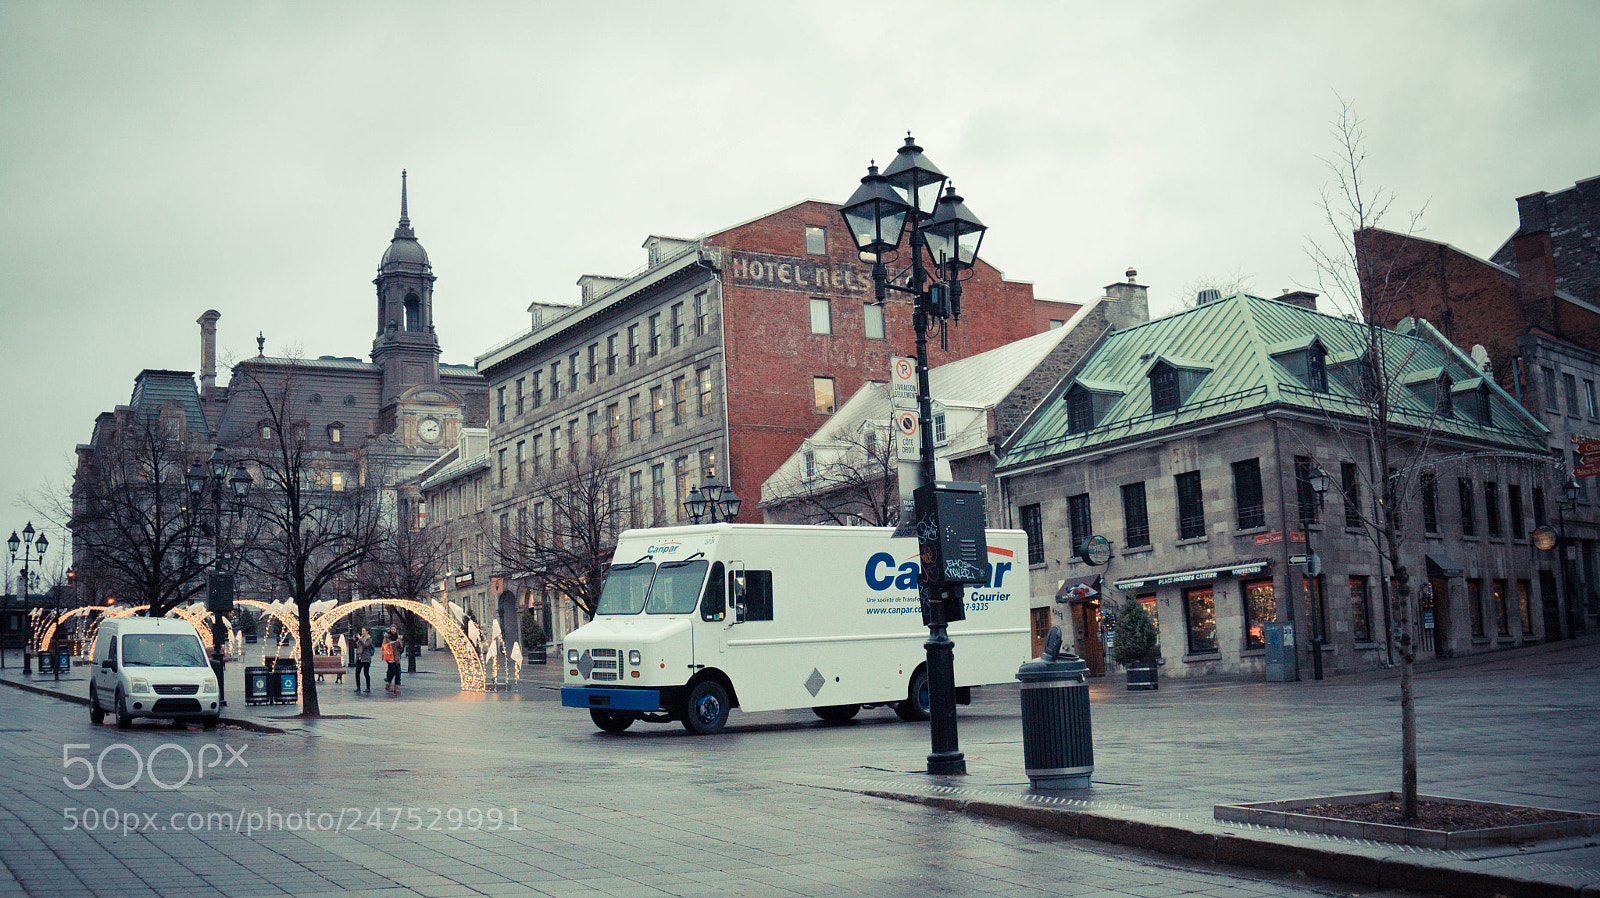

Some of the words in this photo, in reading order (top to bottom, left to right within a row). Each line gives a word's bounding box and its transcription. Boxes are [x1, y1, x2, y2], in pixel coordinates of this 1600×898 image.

[733, 257, 808, 285] HOTEL
[895, 383, 916, 392] LIVRAISON
[901, 446, 915, 454] DROIT
[648, 545, 680, 554] Canpar
[865, 552, 1012, 591] Car
[1158, 577, 1173, 585] PLACE
[1195, 571, 1218, 580] CARTIER
[971, 591, 1011, 602] Courier
[866, 606, 923, 616] www.canpar.co
[964, 602, 989, 612] 7-9335
